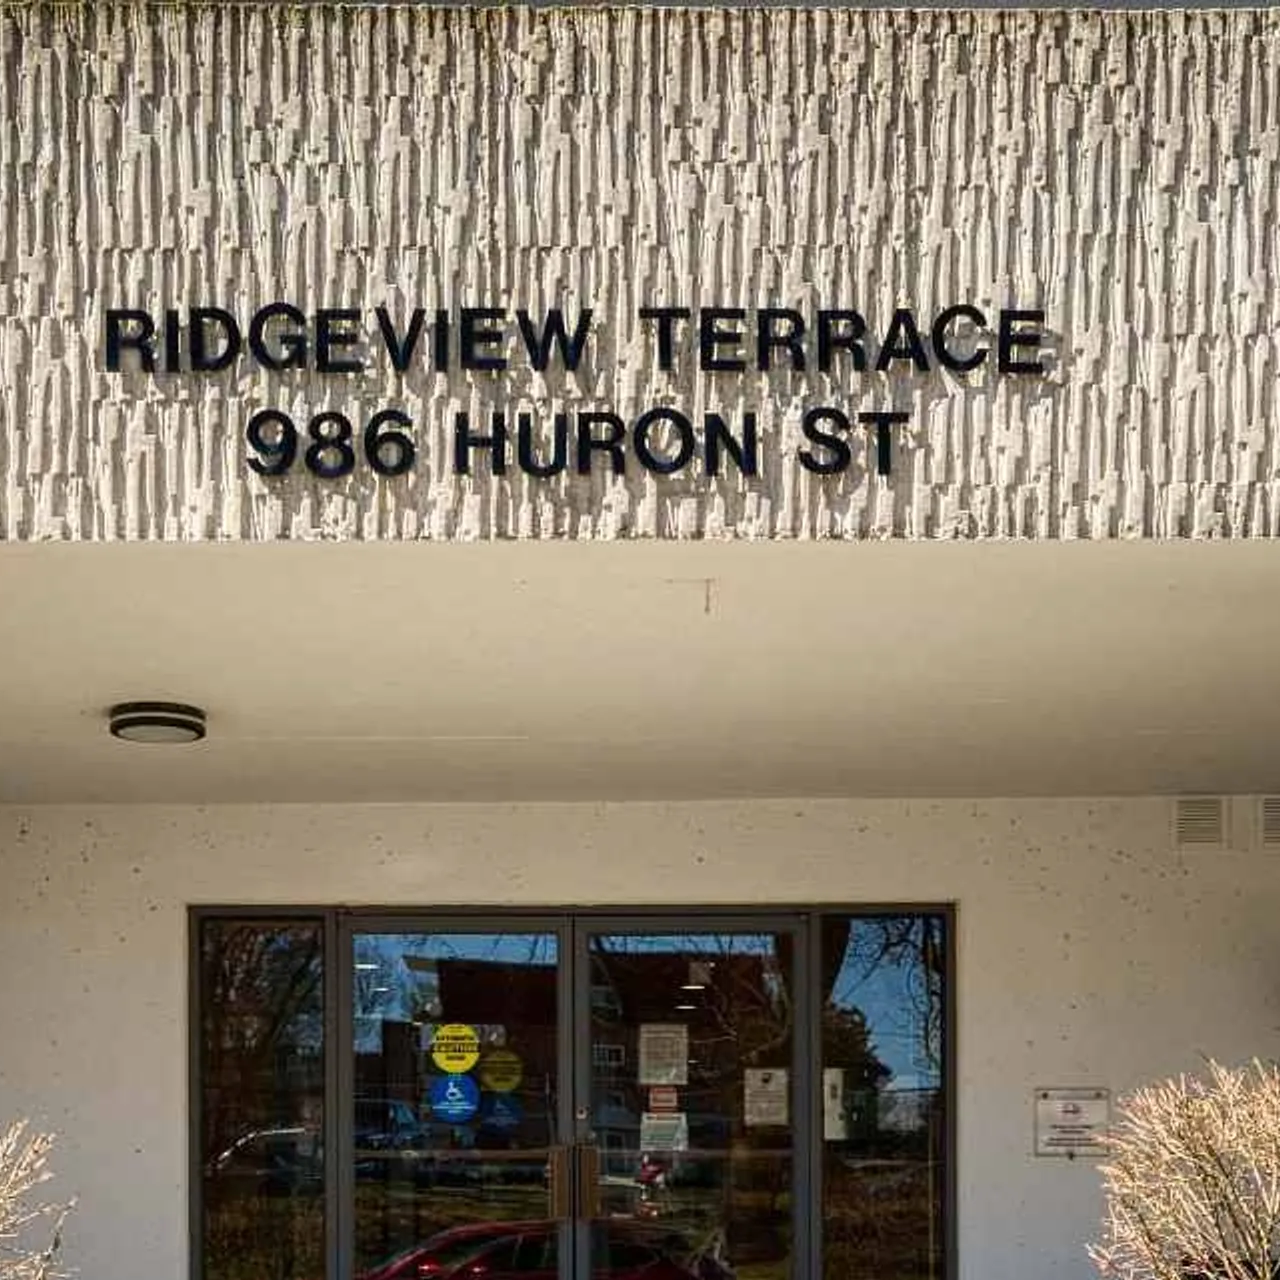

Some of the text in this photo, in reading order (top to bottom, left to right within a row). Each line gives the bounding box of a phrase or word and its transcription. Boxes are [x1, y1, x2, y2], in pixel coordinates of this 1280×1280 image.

[105, 304, 1045, 374] RIDGEVIEW TERRACE
[246, 408, 909, 478] 986 HURON ST
